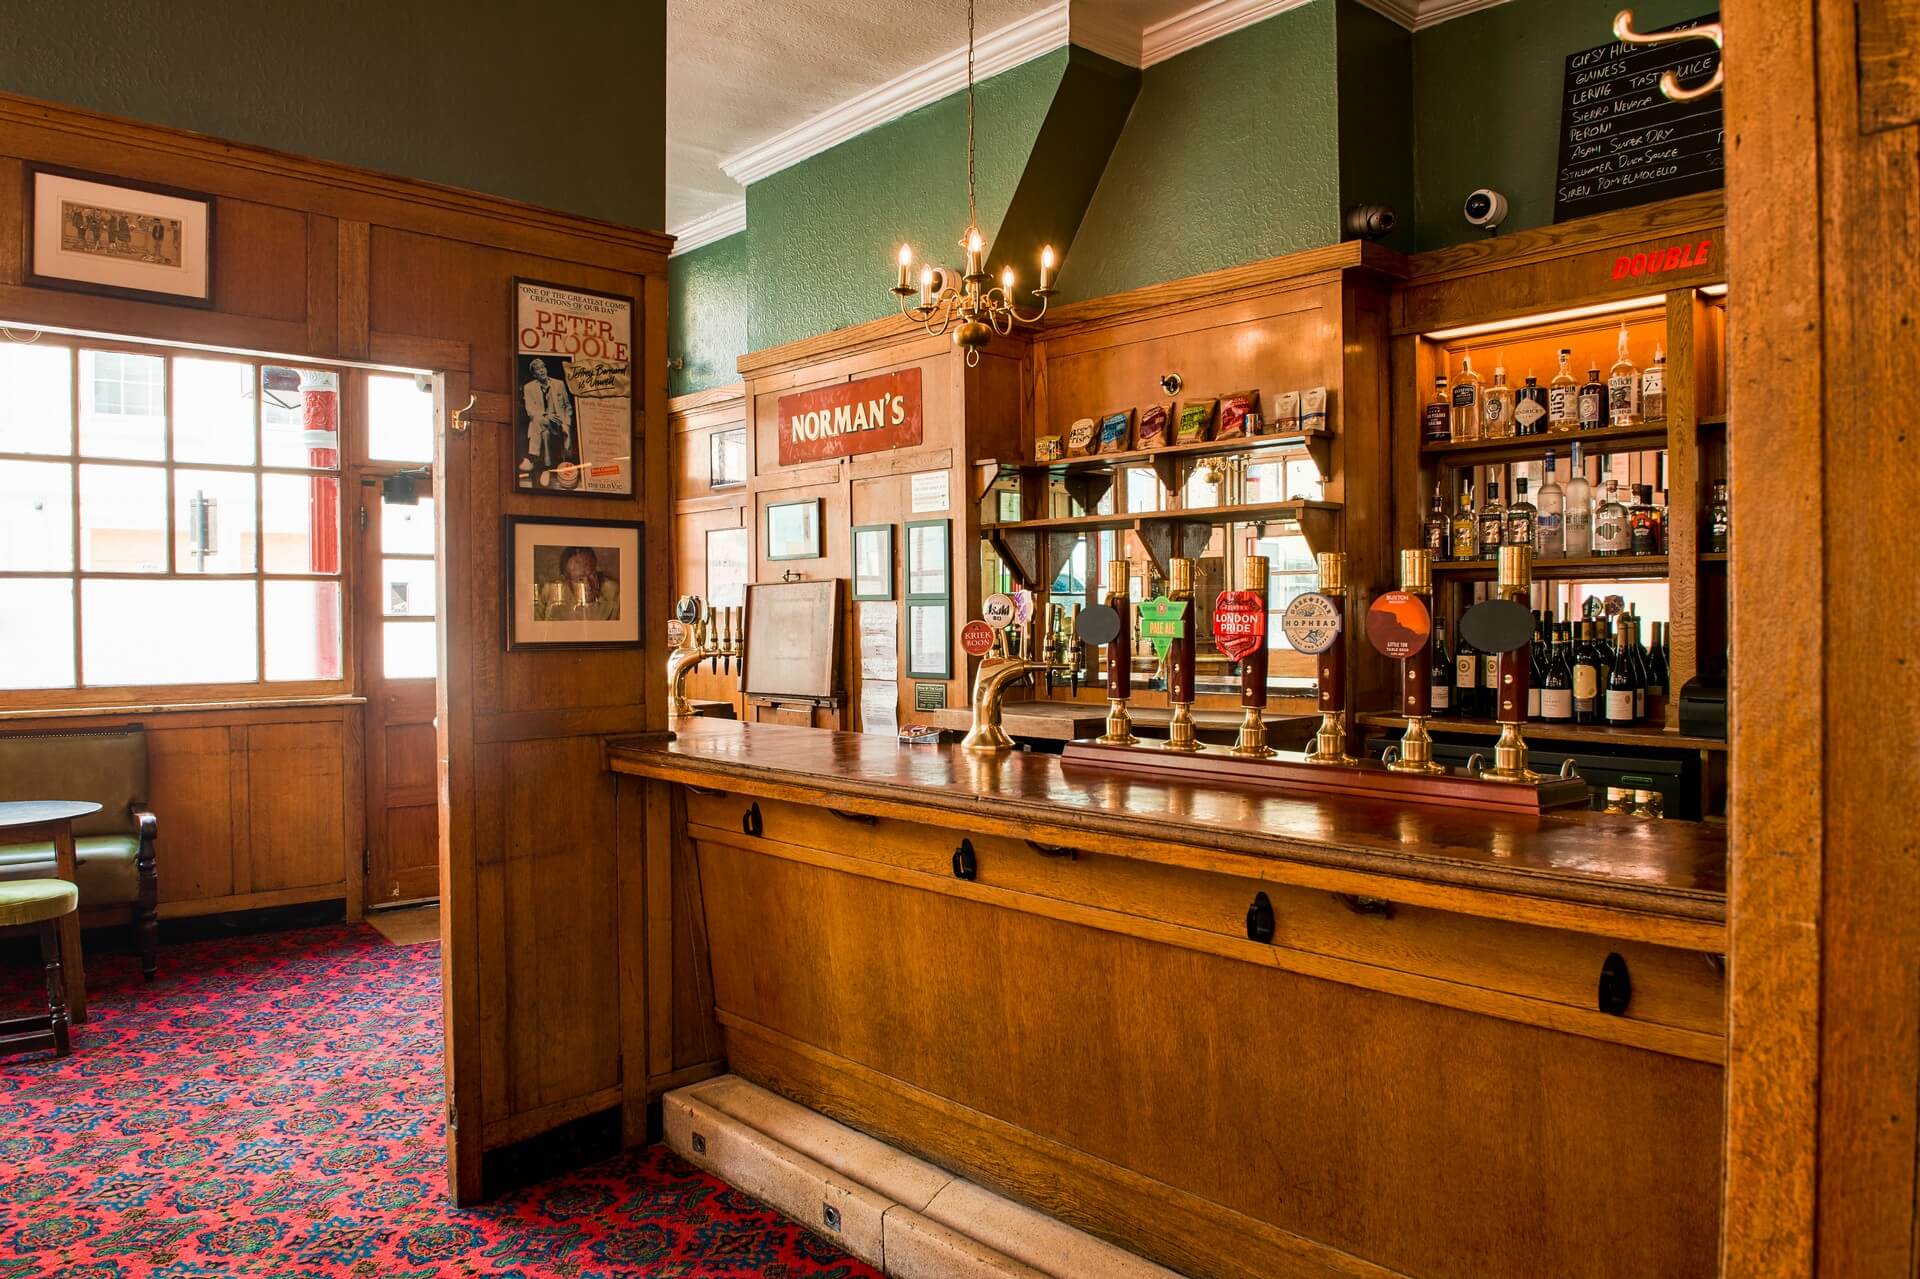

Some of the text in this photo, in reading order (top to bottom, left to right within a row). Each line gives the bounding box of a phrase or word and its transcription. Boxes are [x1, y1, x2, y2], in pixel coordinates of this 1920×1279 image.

[1571, 42, 1638, 69] GIPSY HILL
[1575, 61, 1627, 85] GUINESS
[1572, 83, 1612, 105] LERVIG
[1628, 71, 1665, 89] TAST
[1571, 106, 1609, 123] SIERRA
[1569, 122, 1612, 142] PERONI
[1645, 128, 1675, 144] DRY
[1644, 148, 1679, 163] SAUCE
[1558, 186, 1592, 202] SIREN
[1611, 239, 1711, 281] DOUBLE
[530, 295, 572, 308] CREATIONS
[572, 302, 583, 310] OF
[584, 304, 600, 313] OUR
[540, 289, 551, 297] OF
[552, 291, 567, 300] THE
[567, 293, 604, 308] GREATEST
[605, 301, 630, 311] COMIC
[535, 309, 615, 342] PETER
[520, 327, 629, 362] O'TOOLE
[1551, 386, 1565, 418] JUST
[791, 392, 905, 444] NORMAN'S
[1215, 613, 1258, 624] LONDON
[1220, 623, 1252, 633] PRIDE
[964, 631, 992, 640] KRIEK
